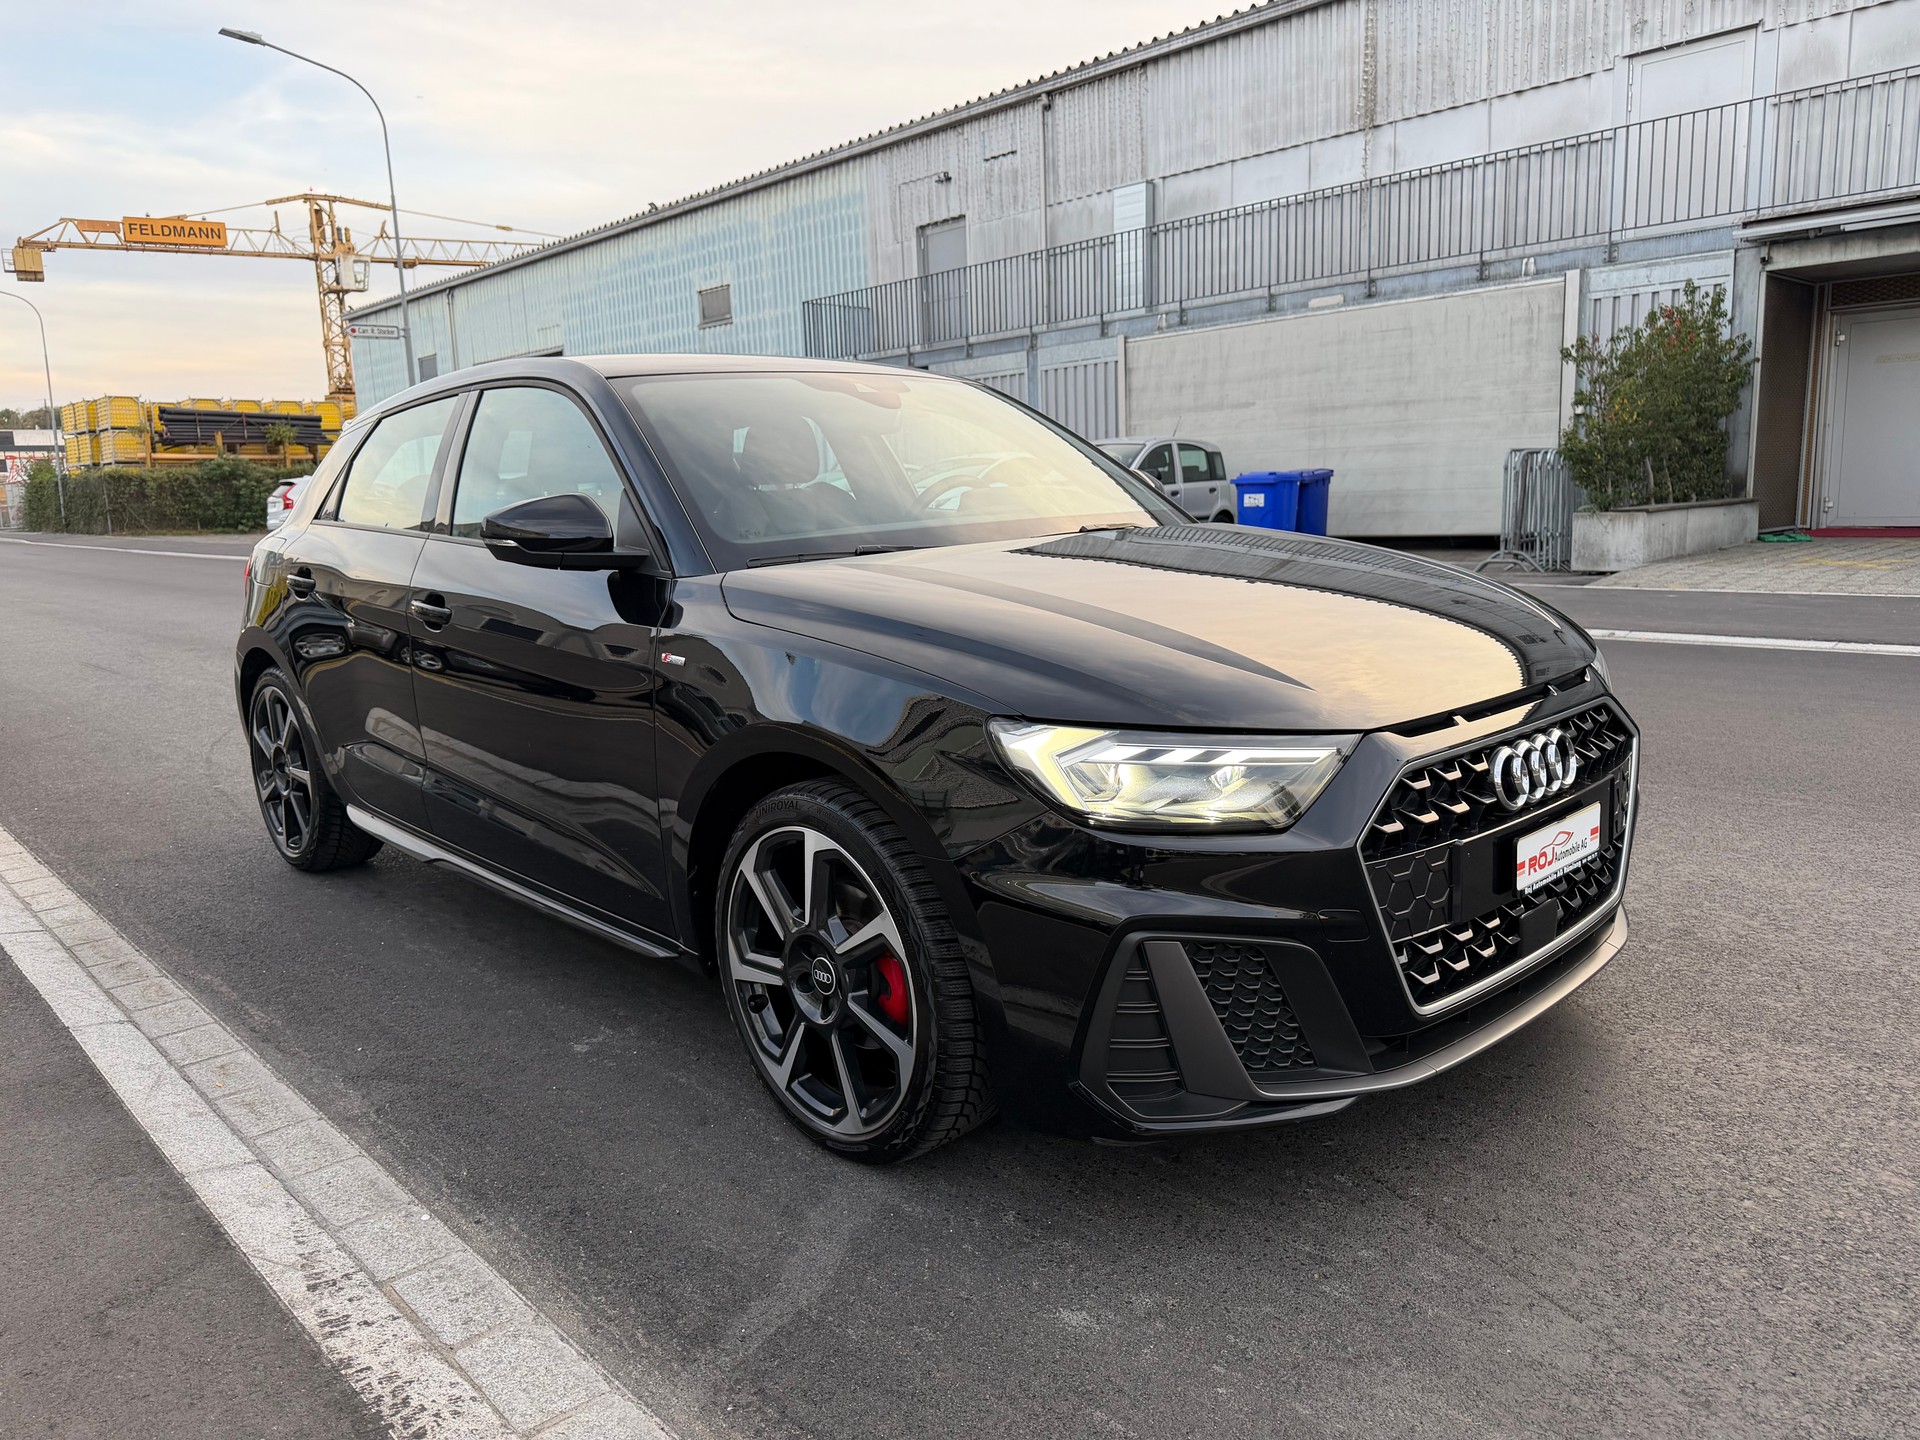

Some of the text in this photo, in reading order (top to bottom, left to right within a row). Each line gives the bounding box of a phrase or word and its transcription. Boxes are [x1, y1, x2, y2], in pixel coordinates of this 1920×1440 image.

[128, 223, 222, 239] FELDMANN
[755, 800, 800, 819] UNIROYAL
[1528, 847, 1555, 876] ROJ
[1554, 841, 1580, 862] Automobile
[1580, 838, 1588, 851] AG
